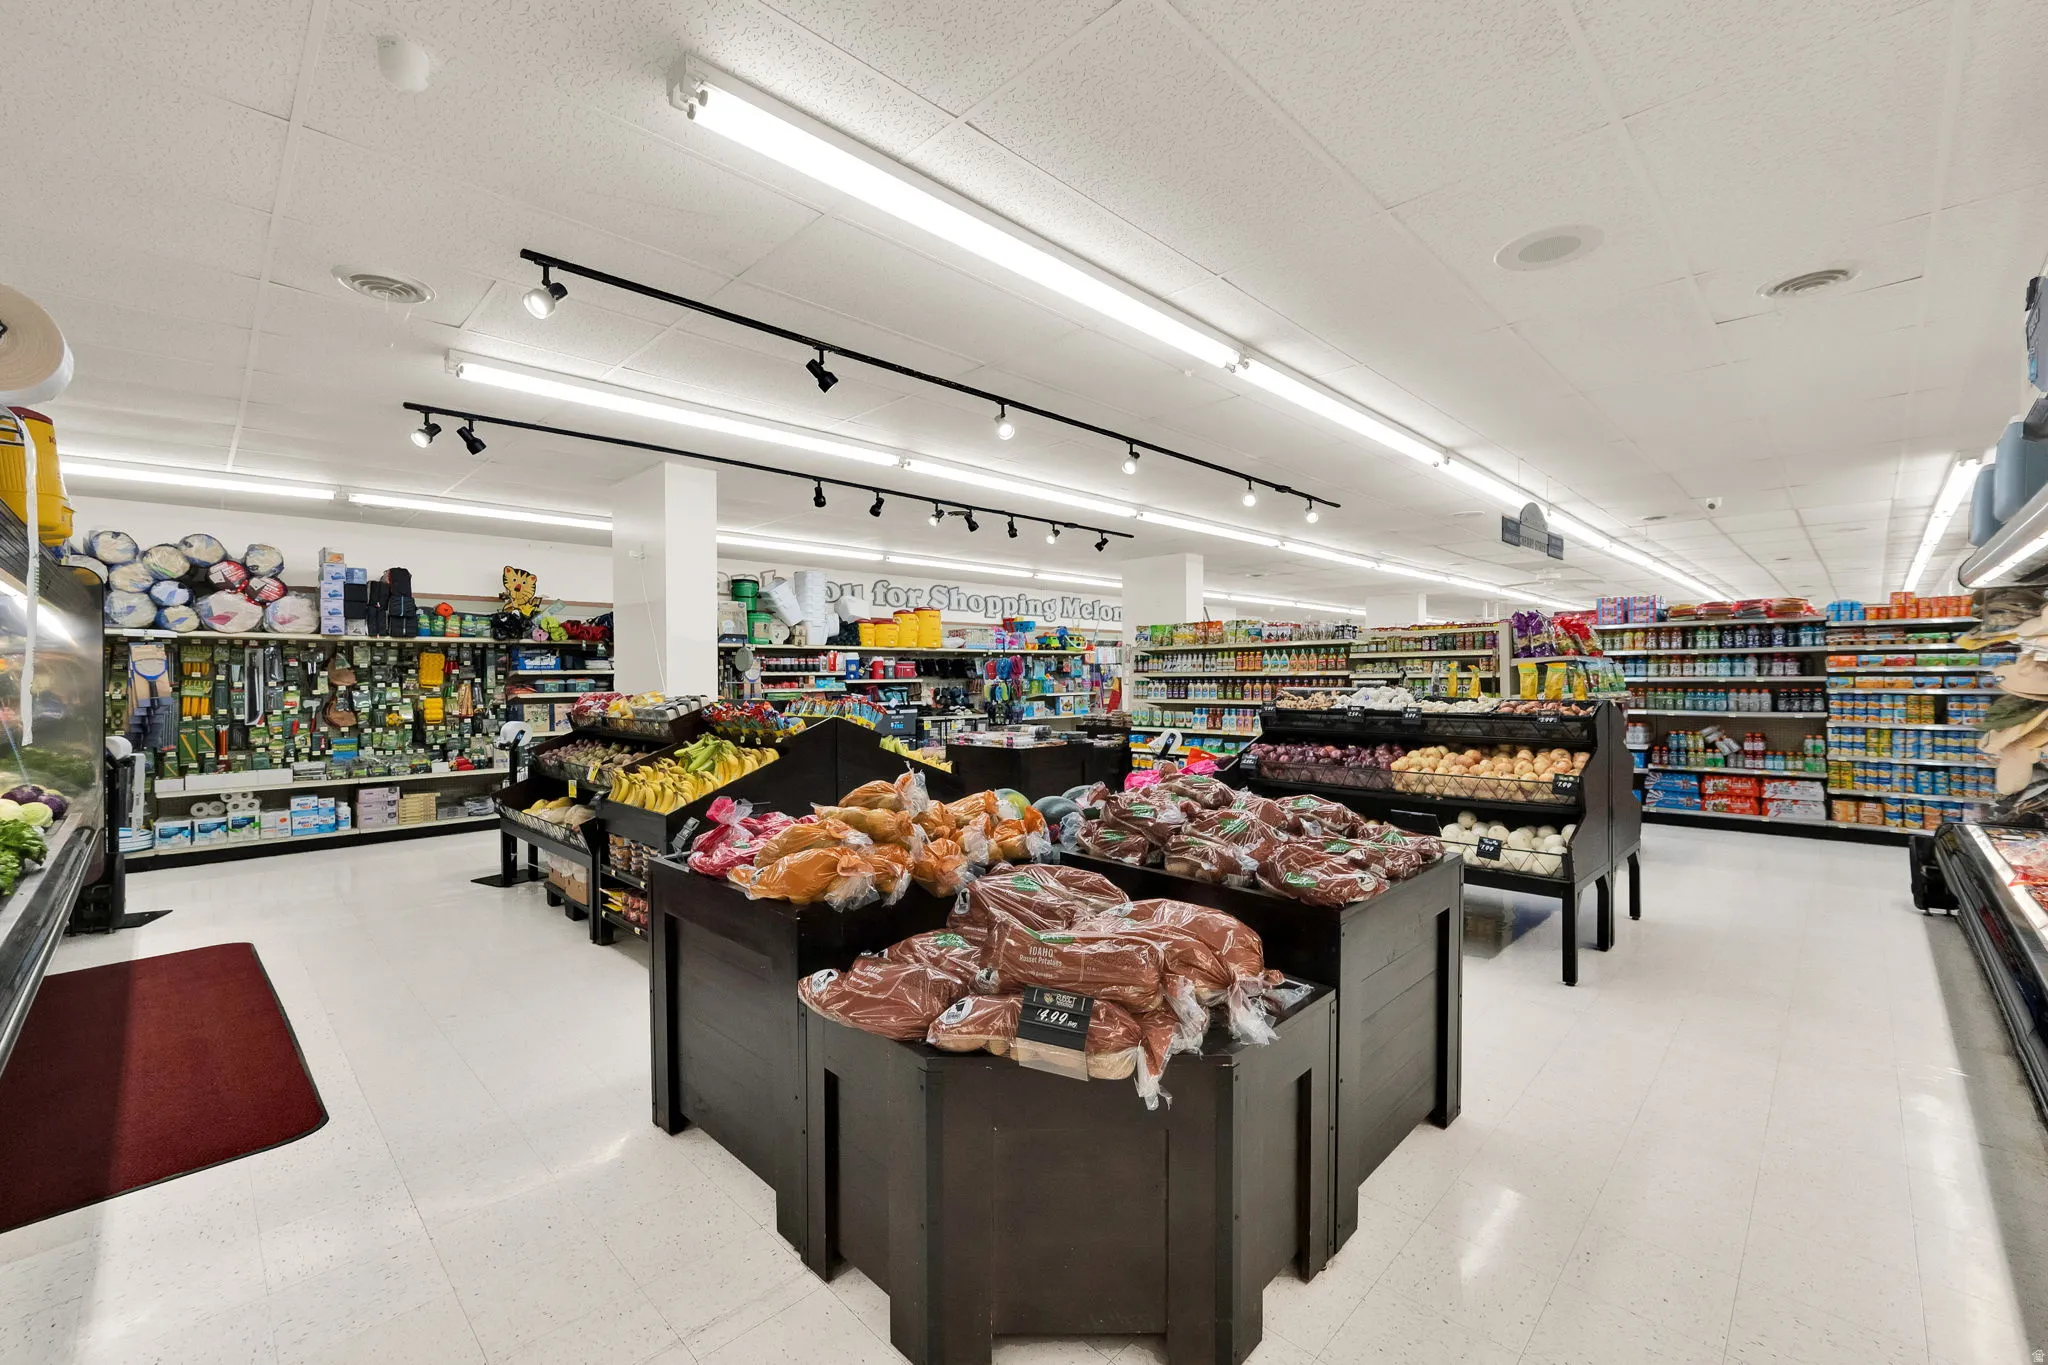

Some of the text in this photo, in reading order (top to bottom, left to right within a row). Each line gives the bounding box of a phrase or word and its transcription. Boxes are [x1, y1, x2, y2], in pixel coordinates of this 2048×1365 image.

[825, 580, 864, 604] ou
[872, 579, 924, 608] for
[927, 584, 1057, 622] Shopping
[1029, 946, 1054, 958] IDAHO
[1019, 954, 1063, 967] Russet Potatoes
